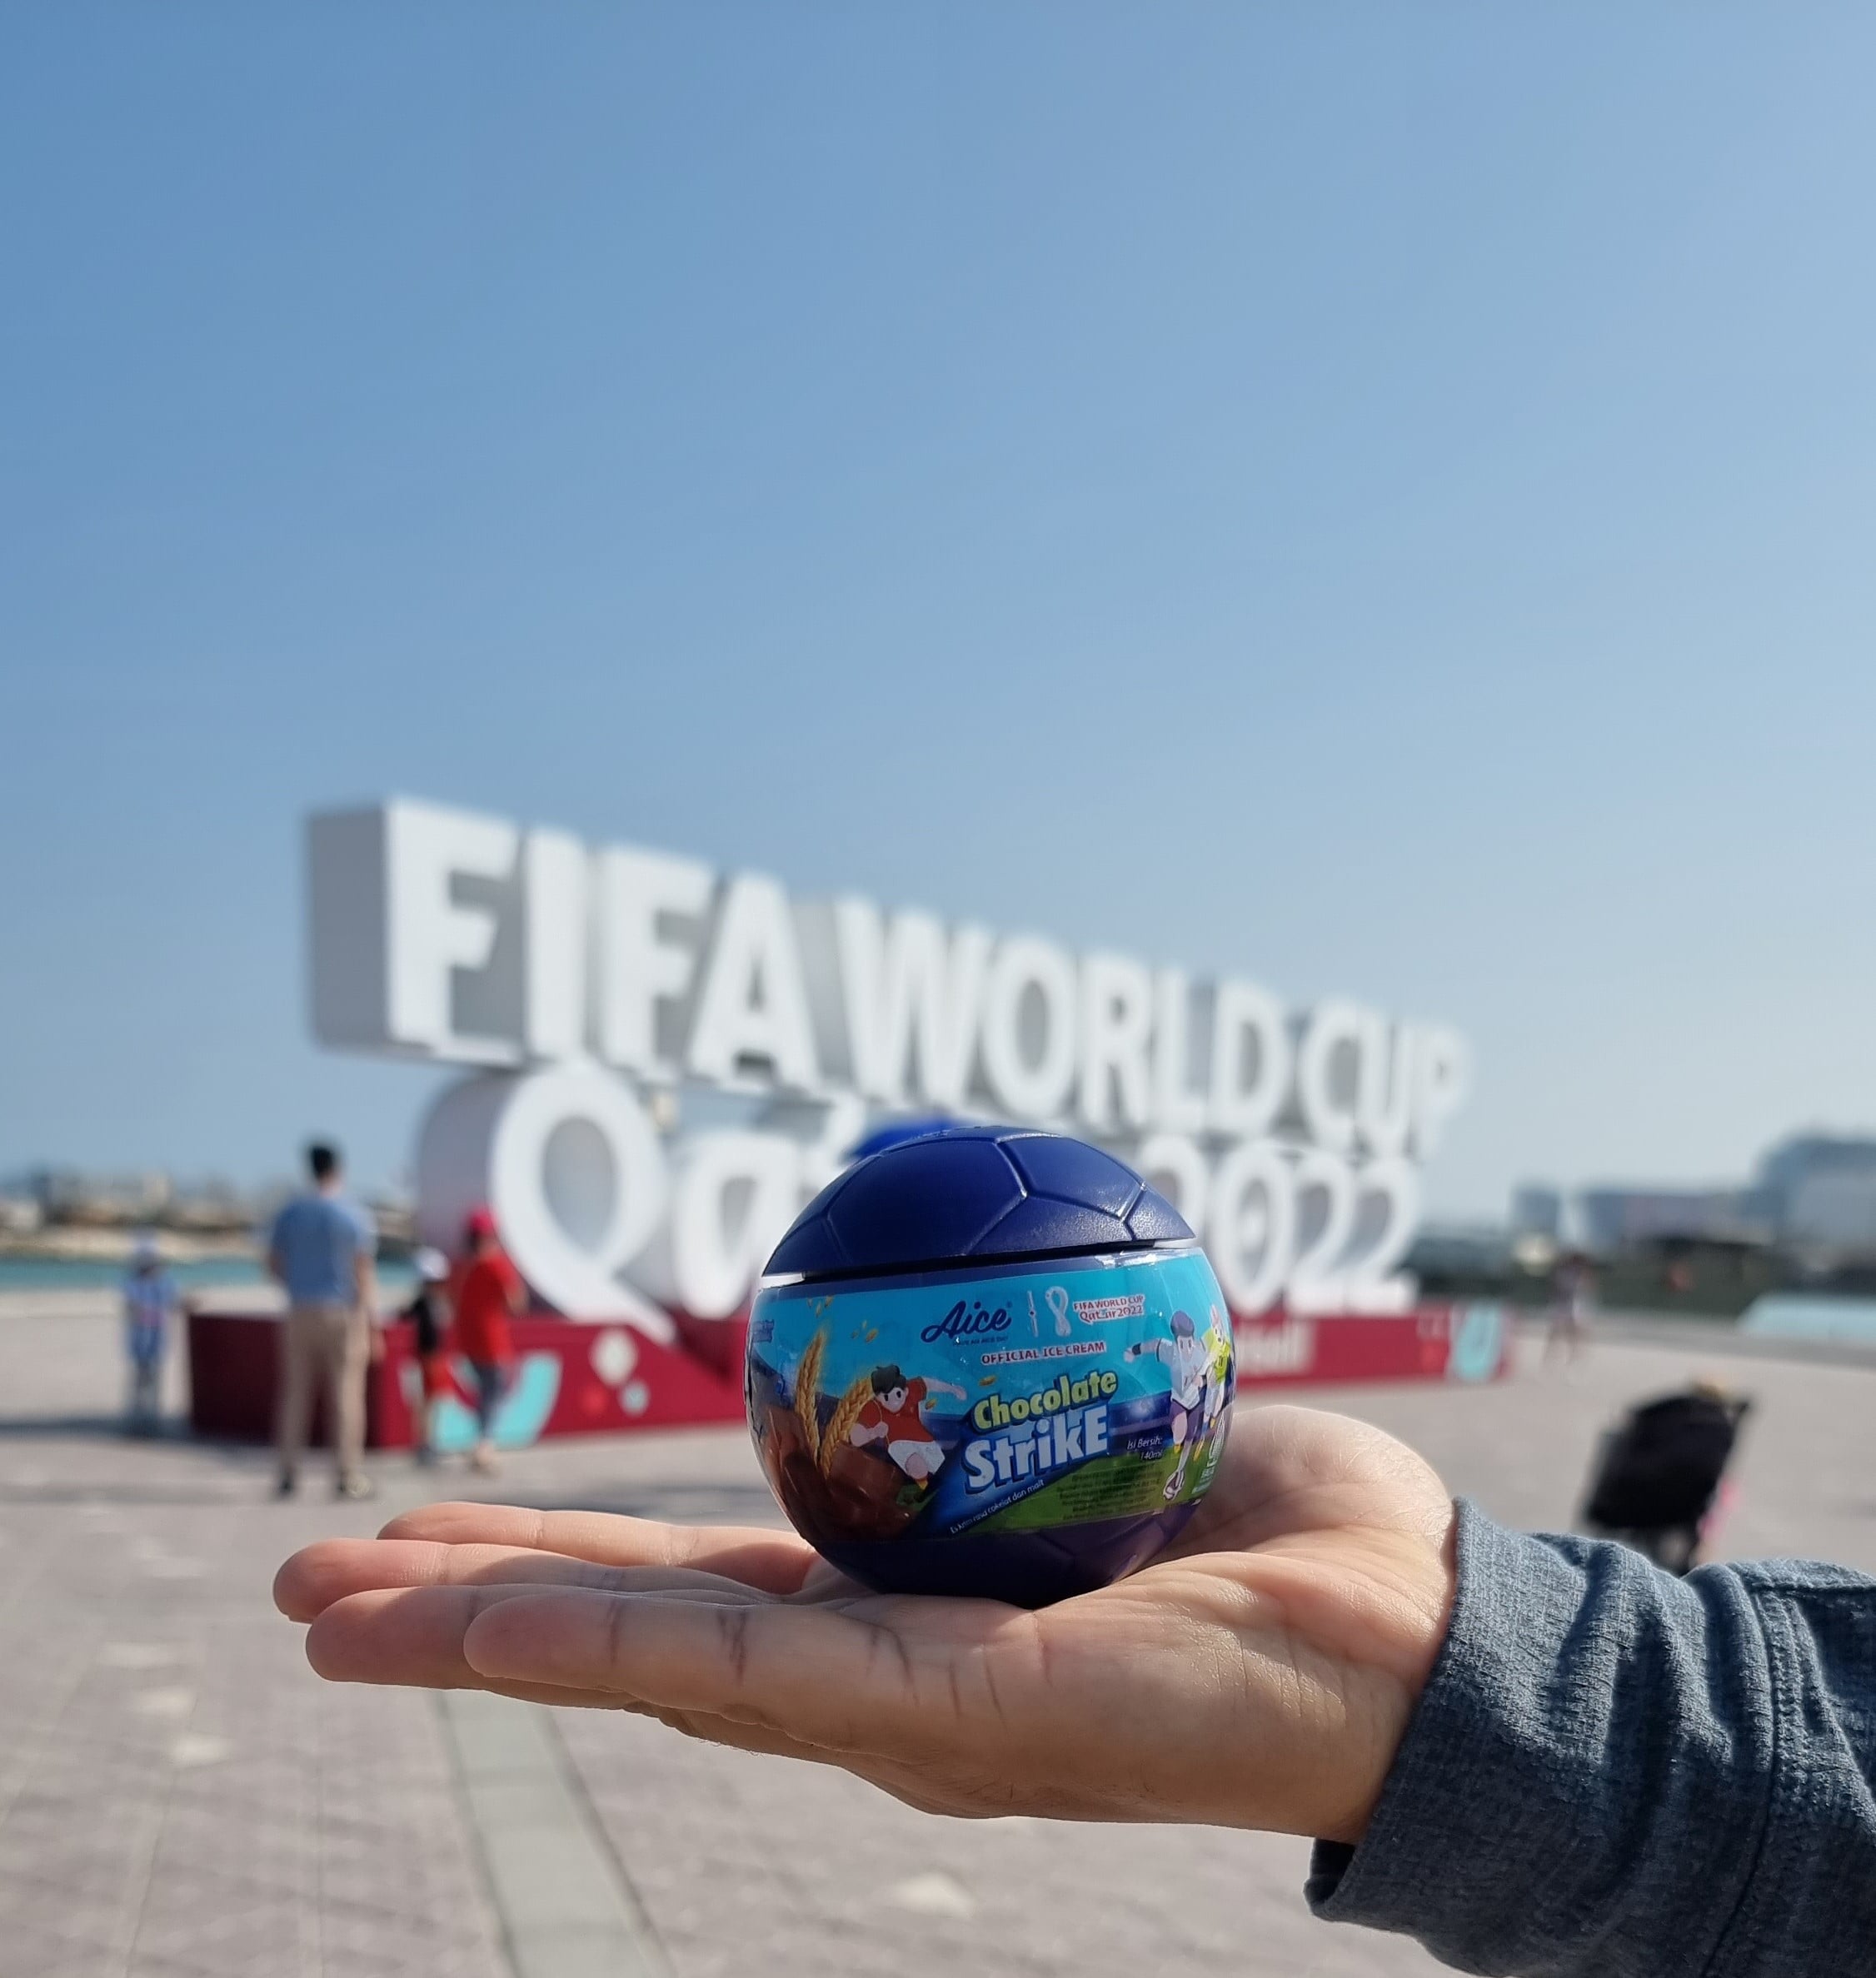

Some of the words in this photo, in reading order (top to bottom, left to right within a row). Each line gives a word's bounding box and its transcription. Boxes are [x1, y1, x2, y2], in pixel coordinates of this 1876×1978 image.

[383, 798, 826, 1093] FIFA
[835, 891, 1294, 1143] WORLD
[1295, 995, 1473, 1164] CUP
[921, 1300, 1011, 1343] Aice
[1074, 1302, 1094, 1311] FIFA
[1095, 1298, 1127, 1308] WORLD
[1128, 1294, 1144, 1304] CUP
[981, 1350, 1040, 1364] OFFICIAL
[1043, 1346, 1063, 1357] ICE
[1065, 1342, 1105, 1354] CREAM
[973, 1371, 1118, 1430] Chocolate
